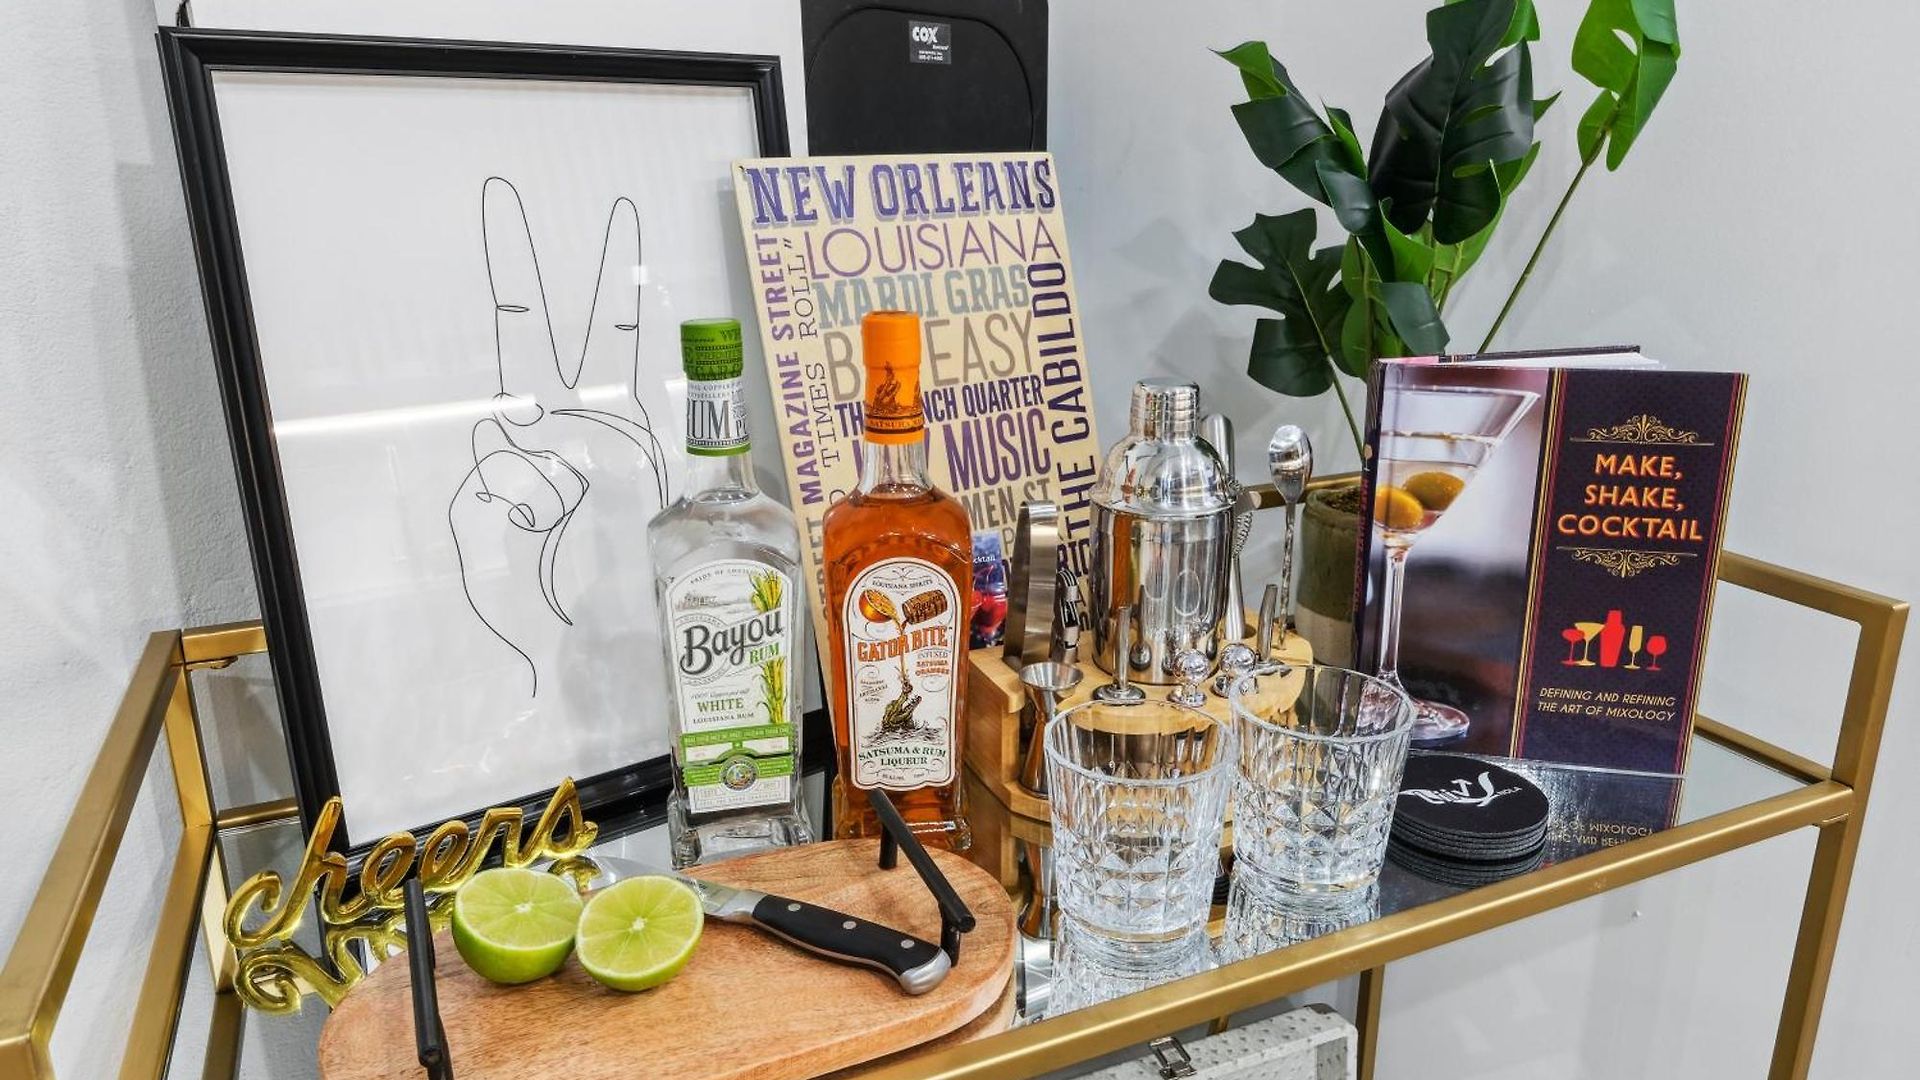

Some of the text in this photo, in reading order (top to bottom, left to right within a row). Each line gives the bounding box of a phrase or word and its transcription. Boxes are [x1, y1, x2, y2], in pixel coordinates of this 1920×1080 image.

[912, 26, 939, 44] COX
[746, 160, 1056, 226] NEW ORLEANS
[804, 216, 1061, 280] LOUISIANA
[810, 263, 1030, 329] MARDI GRAS
[925, 310, 1033, 387] EASY
[1027, 262, 1090, 444] CABILDO
[755, 233, 824, 505] MAGAZINE STREET
[686, 398, 731, 440] UM
[805, 362, 841, 468] TIMES
[835, 375, 1044, 437] TH NCH QUARTER
[943, 407, 1051, 492] MUSIC
[1594, 453, 1684, 481] MAKE,
[1057, 455, 1097, 540] THE
[1584, 484, 1686, 512] SHAKE,
[1557, 513, 1704, 542] COCKTAIL
[973, 554, 996, 563] cktail
[679, 610, 783, 675] Bayou
[750, 641, 780, 664] RUM
[857, 625, 948, 662] GATOR BITE
[697, 697, 745, 713] WHITE
[1537, 701, 1677, 722] THE ART OF MIXOLOGY
[1539, 687, 1677, 708] DEFINING AND REFINING
[693, 712, 755, 724] LOUISIANA RUM
[858, 746, 910, 761] SATSUMA
[922, 746, 947, 758] RUM
[880, 757, 929, 767] LIQUEUR
